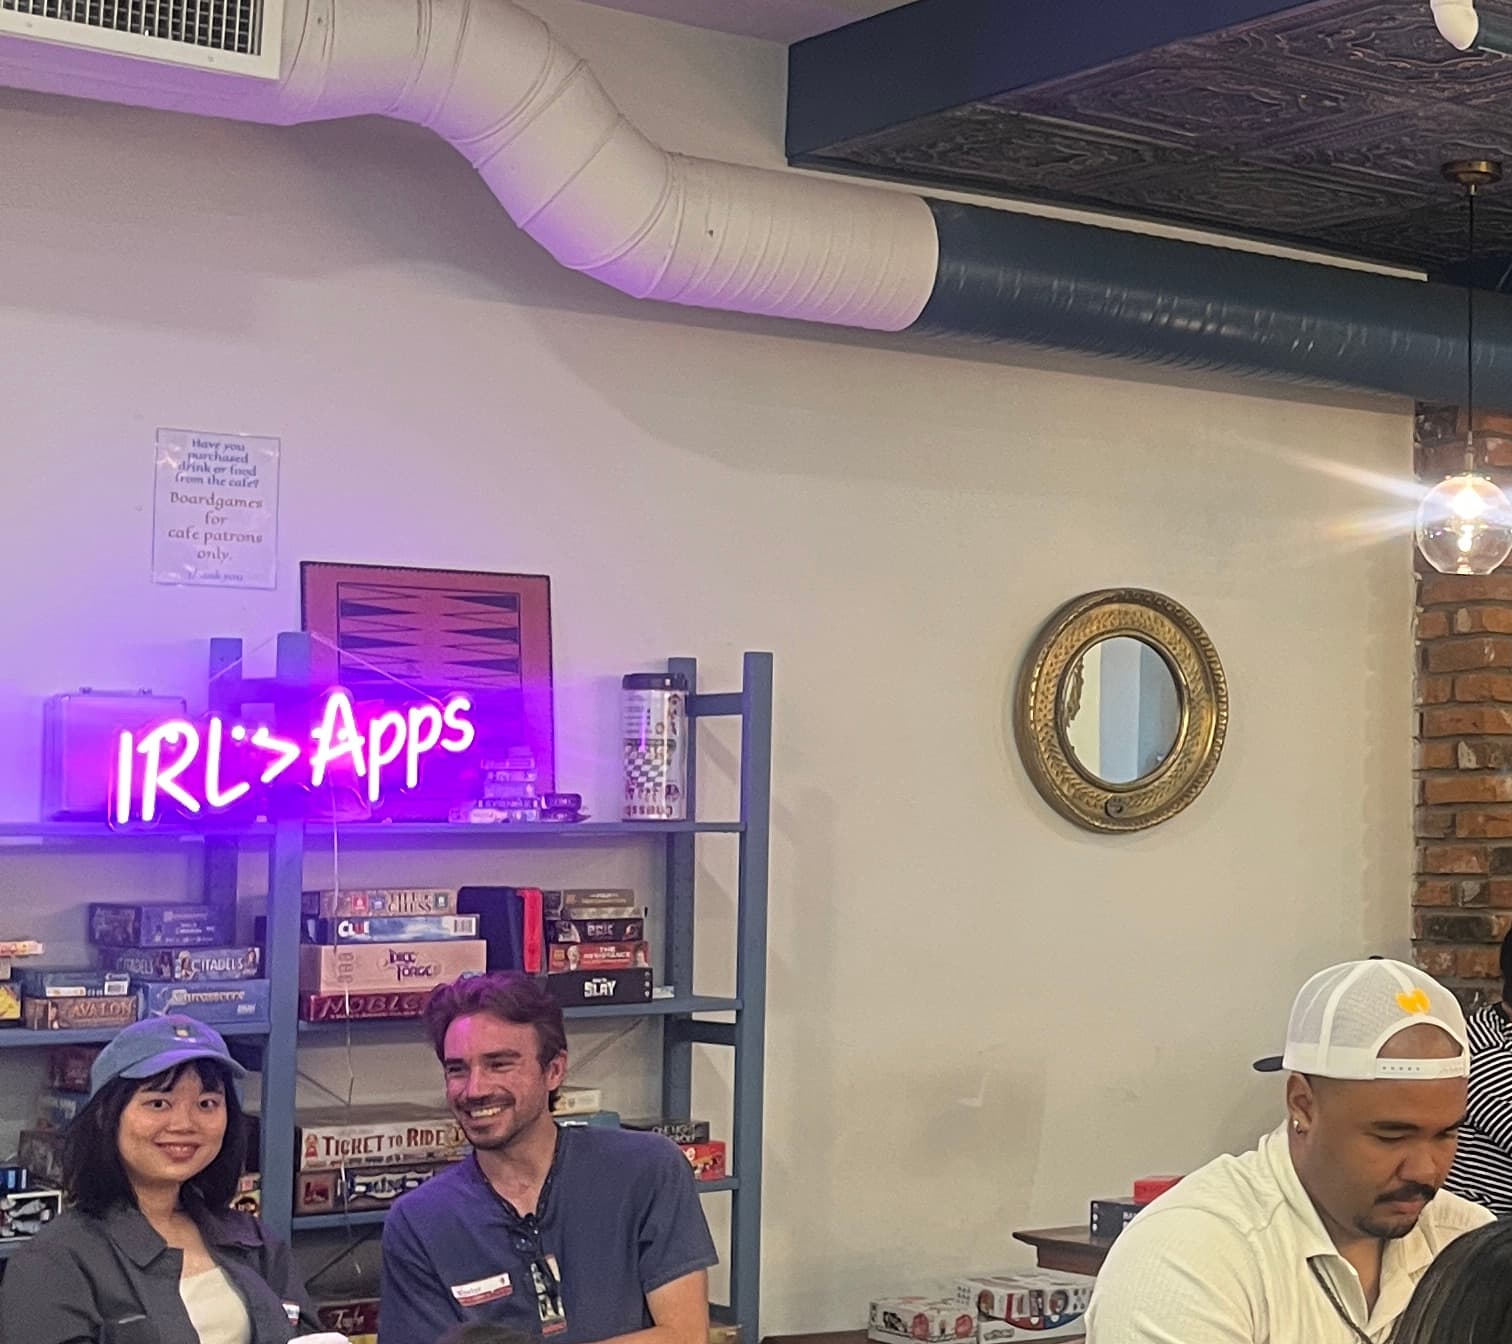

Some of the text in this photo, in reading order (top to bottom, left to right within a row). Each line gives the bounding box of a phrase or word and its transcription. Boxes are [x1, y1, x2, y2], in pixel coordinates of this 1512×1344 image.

[192, 438, 246, 452] Have you
[187, 452, 249, 463] purchased
[177, 460, 257, 476] drink or food
[175, 472, 204, 485] from
[207, 474, 226, 487] the
[169, 491, 263, 511] Boardgames
[204, 510, 228, 526] for
[168, 525, 263, 545] cafe patrons
[196, 546, 233, 565] only.
[116, 716, 250, 824] IRL
[310, 692, 475, 802] Apps
[191, 957, 244, 973] CITADELS
[584, 980, 616, 998] SLAY
[72, 1001, 134, 1019] AVALON
[322, 1134, 385, 1156] TICKET
[406, 1128, 446, 1148] RIDE
